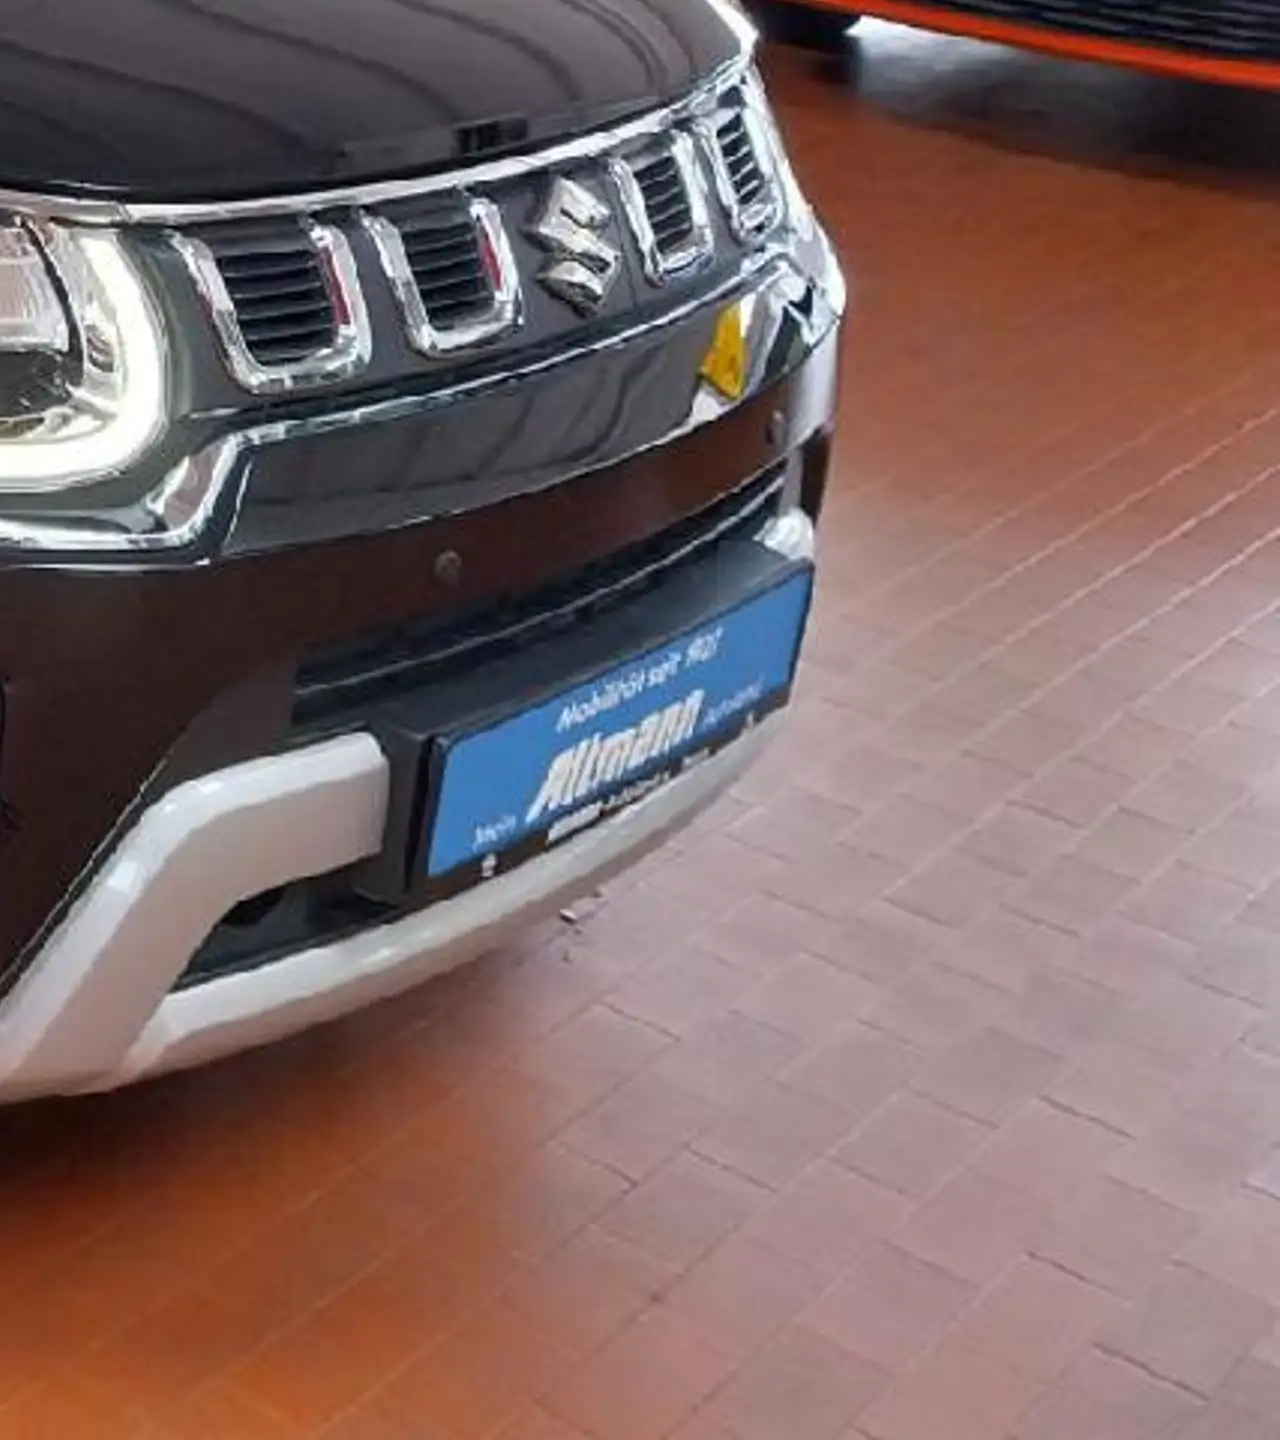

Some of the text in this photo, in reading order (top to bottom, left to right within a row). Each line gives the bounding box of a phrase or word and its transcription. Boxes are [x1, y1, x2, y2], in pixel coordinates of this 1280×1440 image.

[555, 668, 647, 733] Mobilität
[646, 651, 683, 688] seit
[524, 687, 706, 825] Altmann
